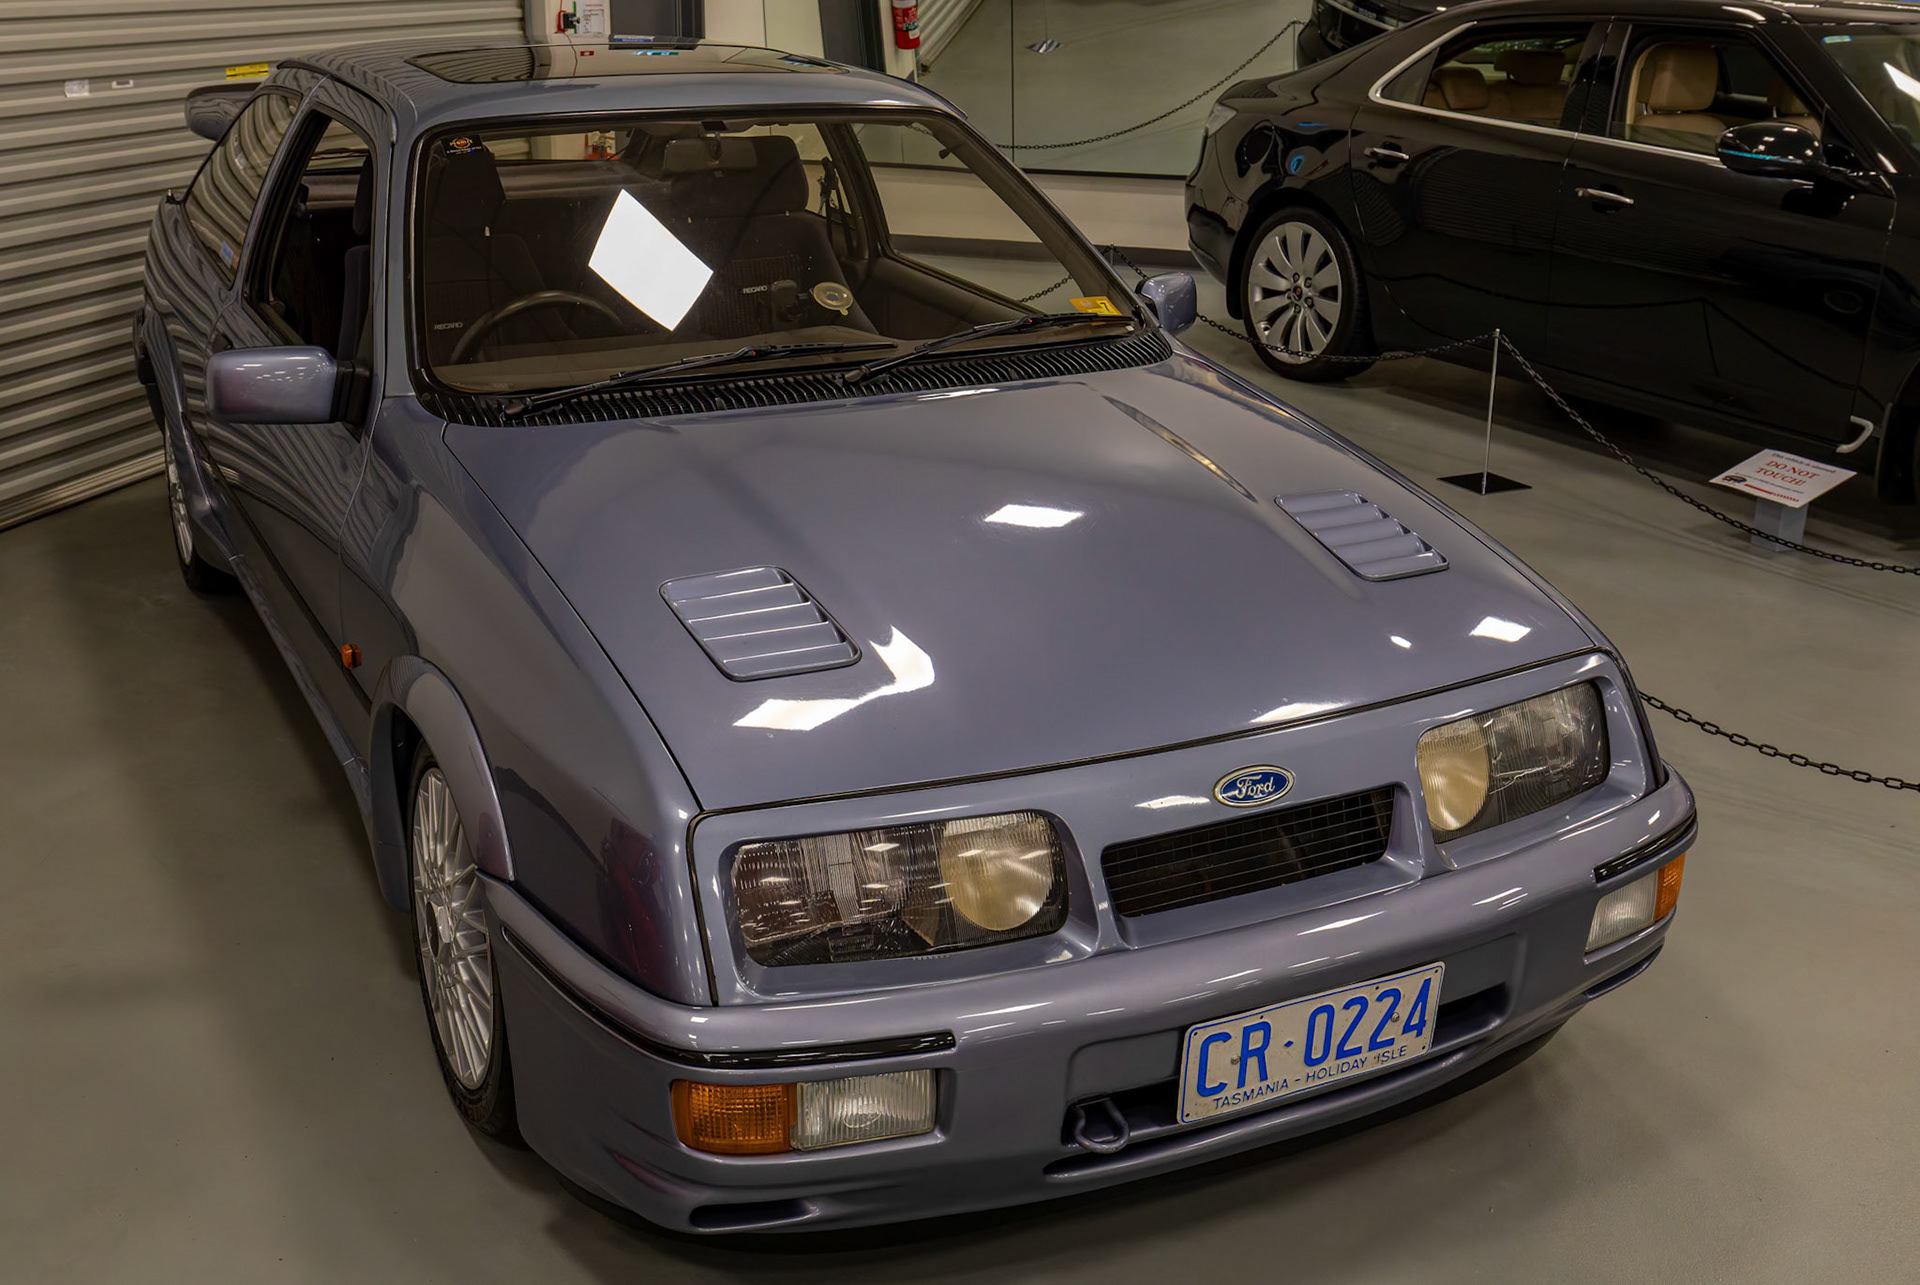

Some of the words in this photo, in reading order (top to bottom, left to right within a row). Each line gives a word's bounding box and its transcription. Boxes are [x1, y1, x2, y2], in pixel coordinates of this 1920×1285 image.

[742, 285, 768, 295] RECARO
[434, 321, 463, 331] RECARO
[1755, 467, 1807, 487] TOUCH!
[1766, 460, 1788, 470] DO
[1788, 466, 1821, 480] NOT
[1235, 774, 1276, 799] Ford
[1213, 1078, 1289, 1110] TASMANIA
[1306, 1058, 1368, 1083] HOLIDAY
[1376, 1044, 1408, 1064] ISLE
